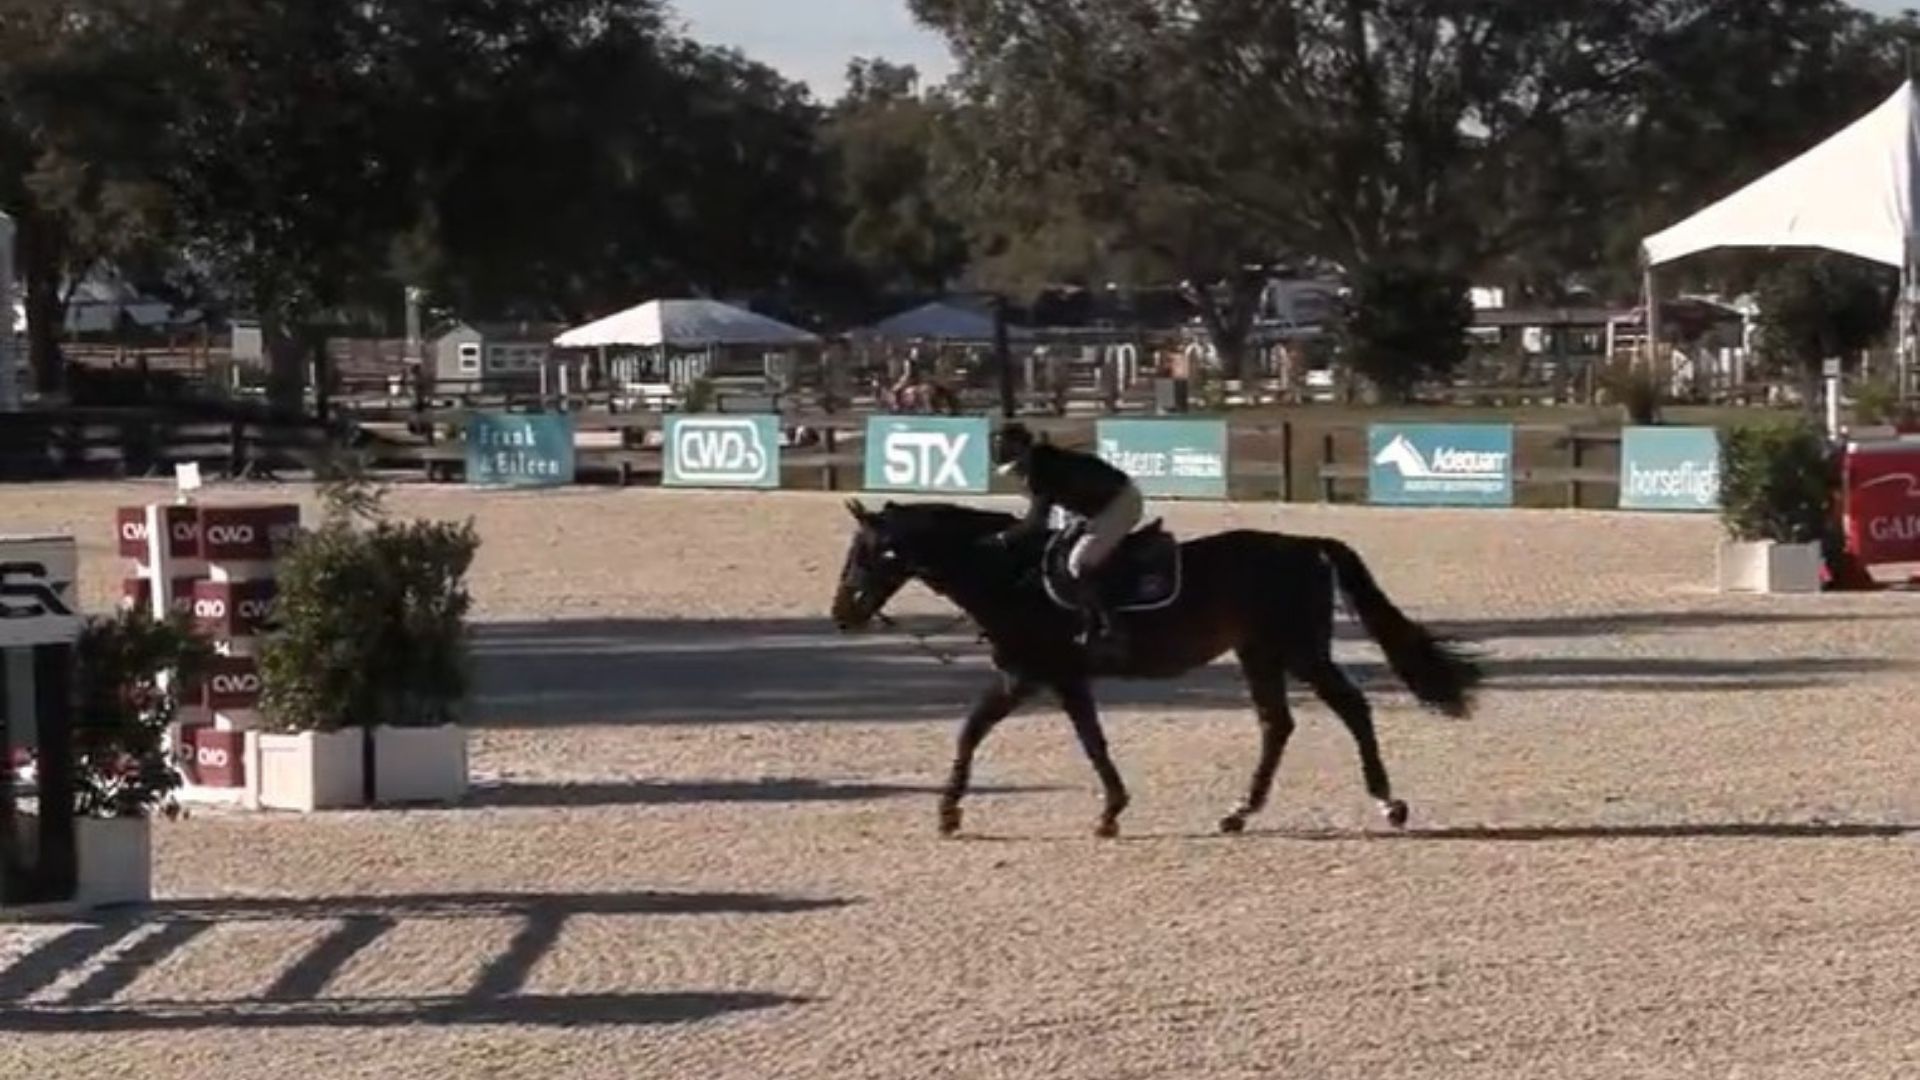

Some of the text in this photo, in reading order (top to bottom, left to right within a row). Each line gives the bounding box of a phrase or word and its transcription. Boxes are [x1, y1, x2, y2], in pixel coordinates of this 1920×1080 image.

[497, 451, 559, 475] Eileen
[884, 432, 969, 486] STX
[208, 525, 254, 544] CWD
[212, 673, 260, 693] CWD
